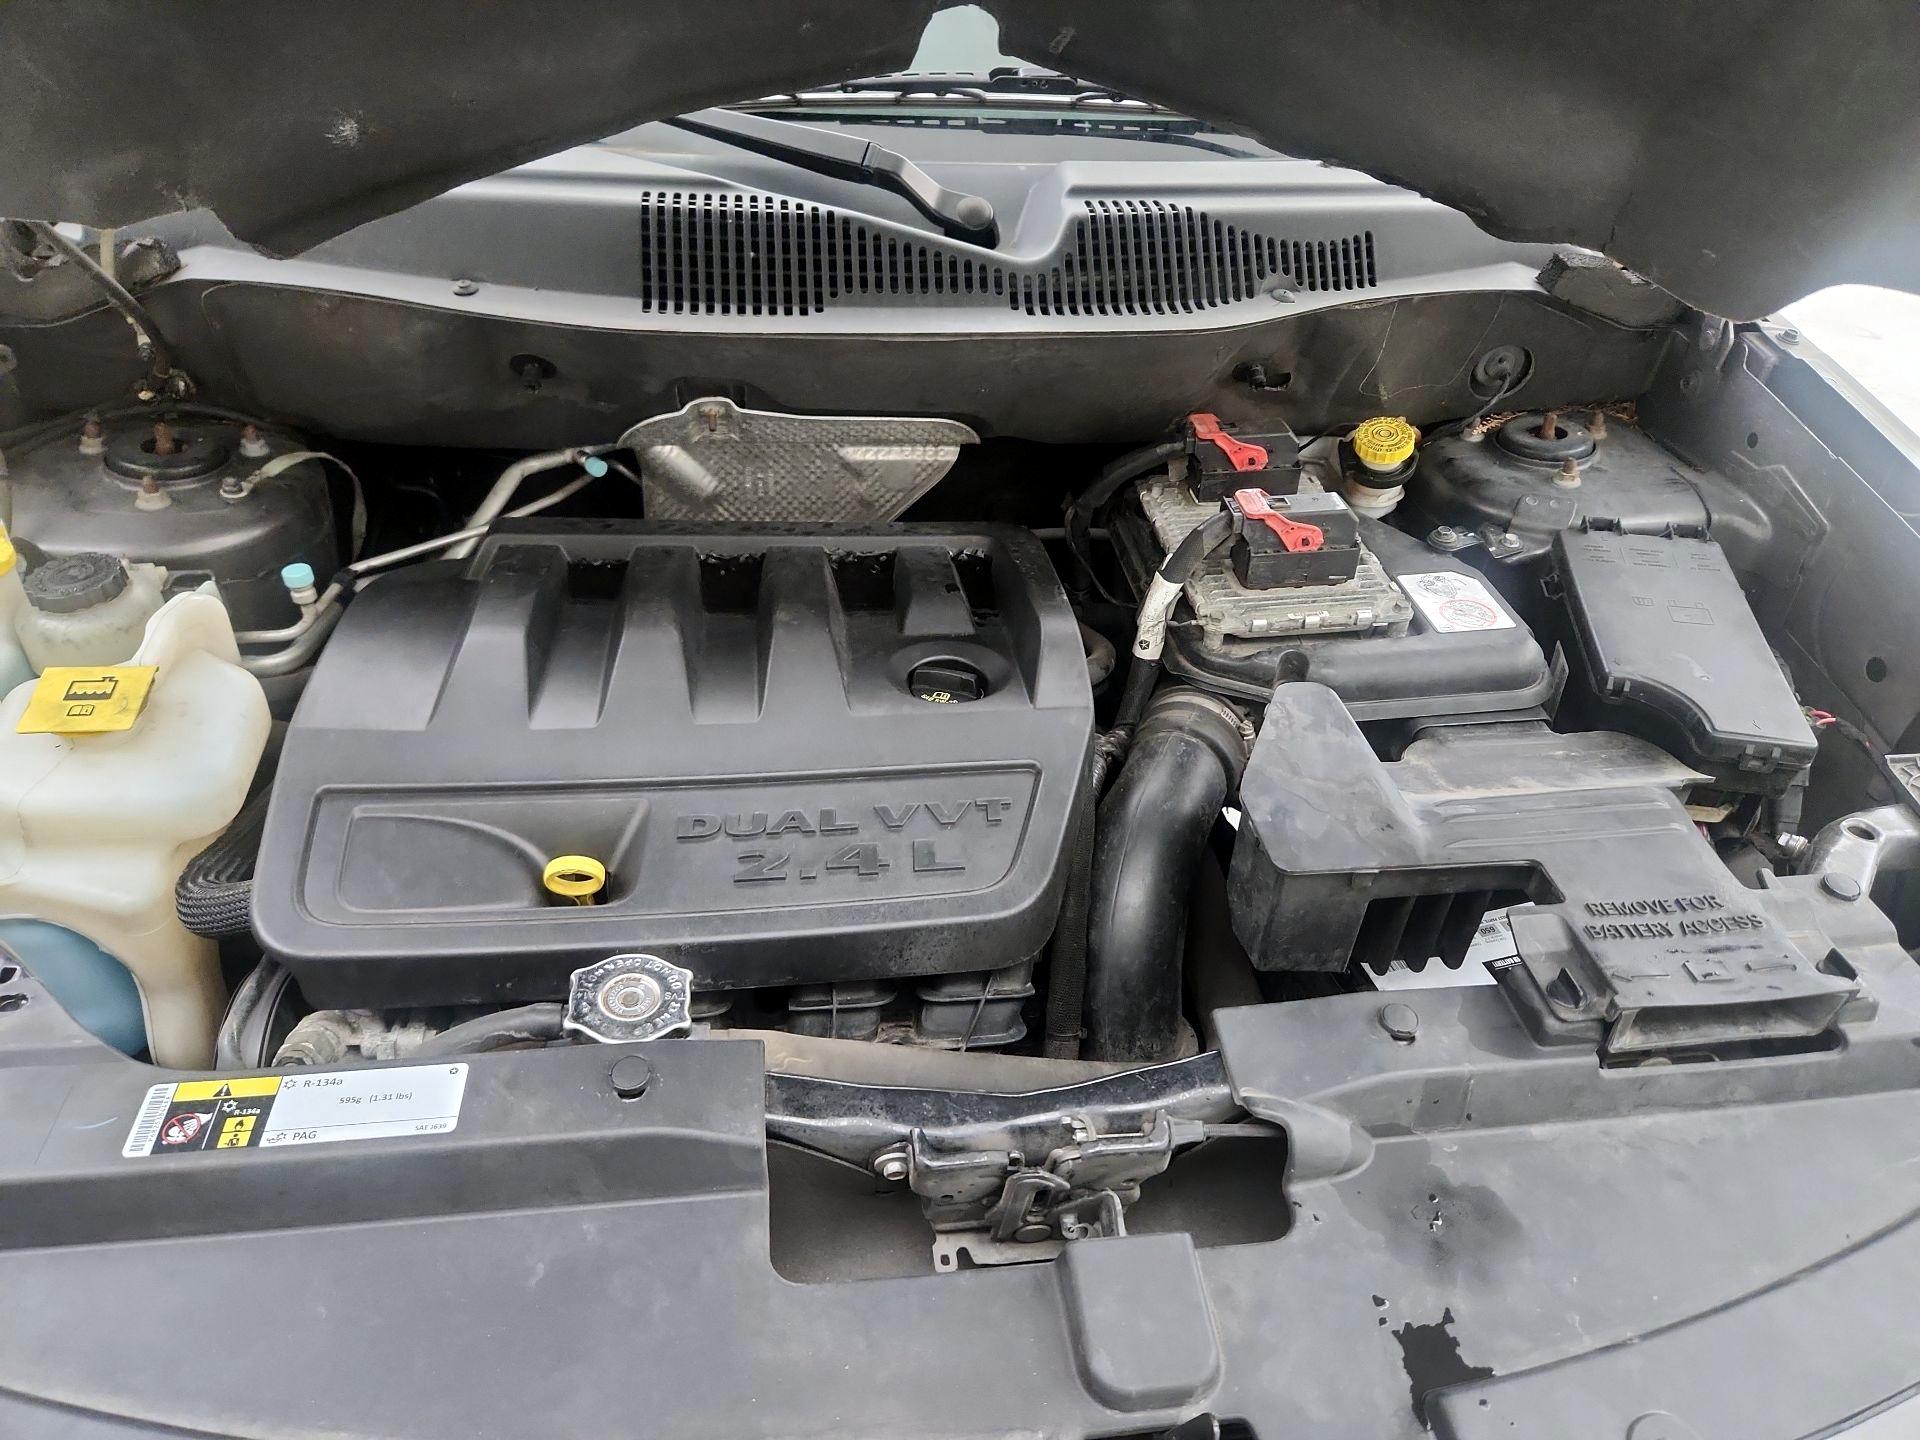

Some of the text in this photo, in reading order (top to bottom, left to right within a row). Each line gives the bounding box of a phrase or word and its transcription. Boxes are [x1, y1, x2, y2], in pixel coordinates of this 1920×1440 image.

[676, 797, 1012, 840] DUAL VVT
[1584, 894, 1725, 917] REMOVE FOR
[1480, 926, 1497, 935] 650
[1583, 914, 1767, 940] BATTERY ACCESS
[302, 1076, 344, 1089] R-134a
[338, 1090, 414, 1106] 595g (1.31 lbs)
[233, 1107, 261, 1116] R-134a
[291, 1130, 317, 1142] PAG
